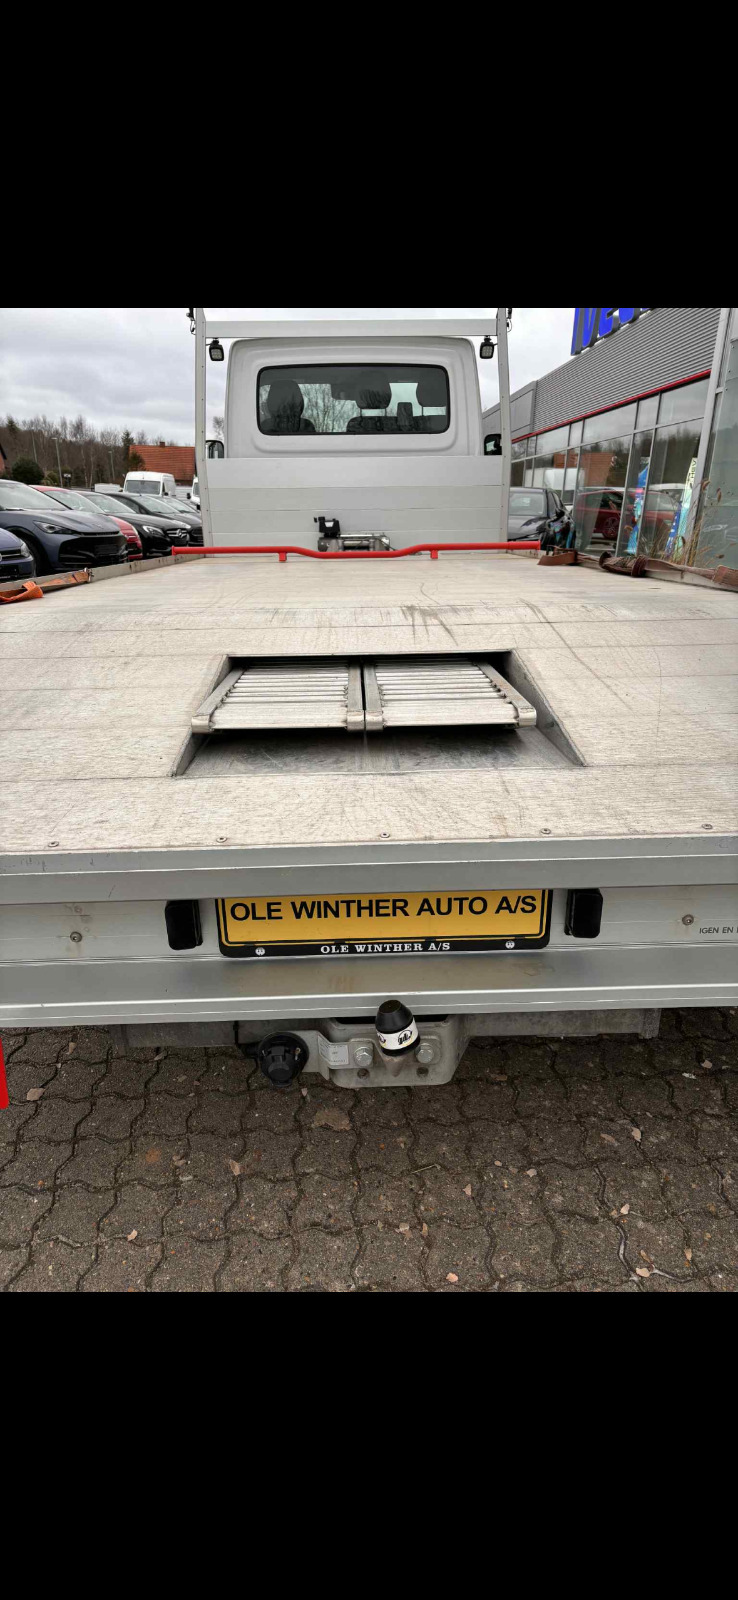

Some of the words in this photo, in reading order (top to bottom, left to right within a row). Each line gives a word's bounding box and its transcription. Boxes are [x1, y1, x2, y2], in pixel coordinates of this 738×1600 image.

[230, 902, 283, 921] OLE
[290, 898, 410, 919] WINTHER
[416, 896, 488, 916] AUTO
[494, 895, 537, 914] A/S
[722, 926, 734, 934] EN
[320, 945, 349, 954] OLE
[354, 943, 423, 953] WINTHER
[428, 942, 450, 951] A/S
